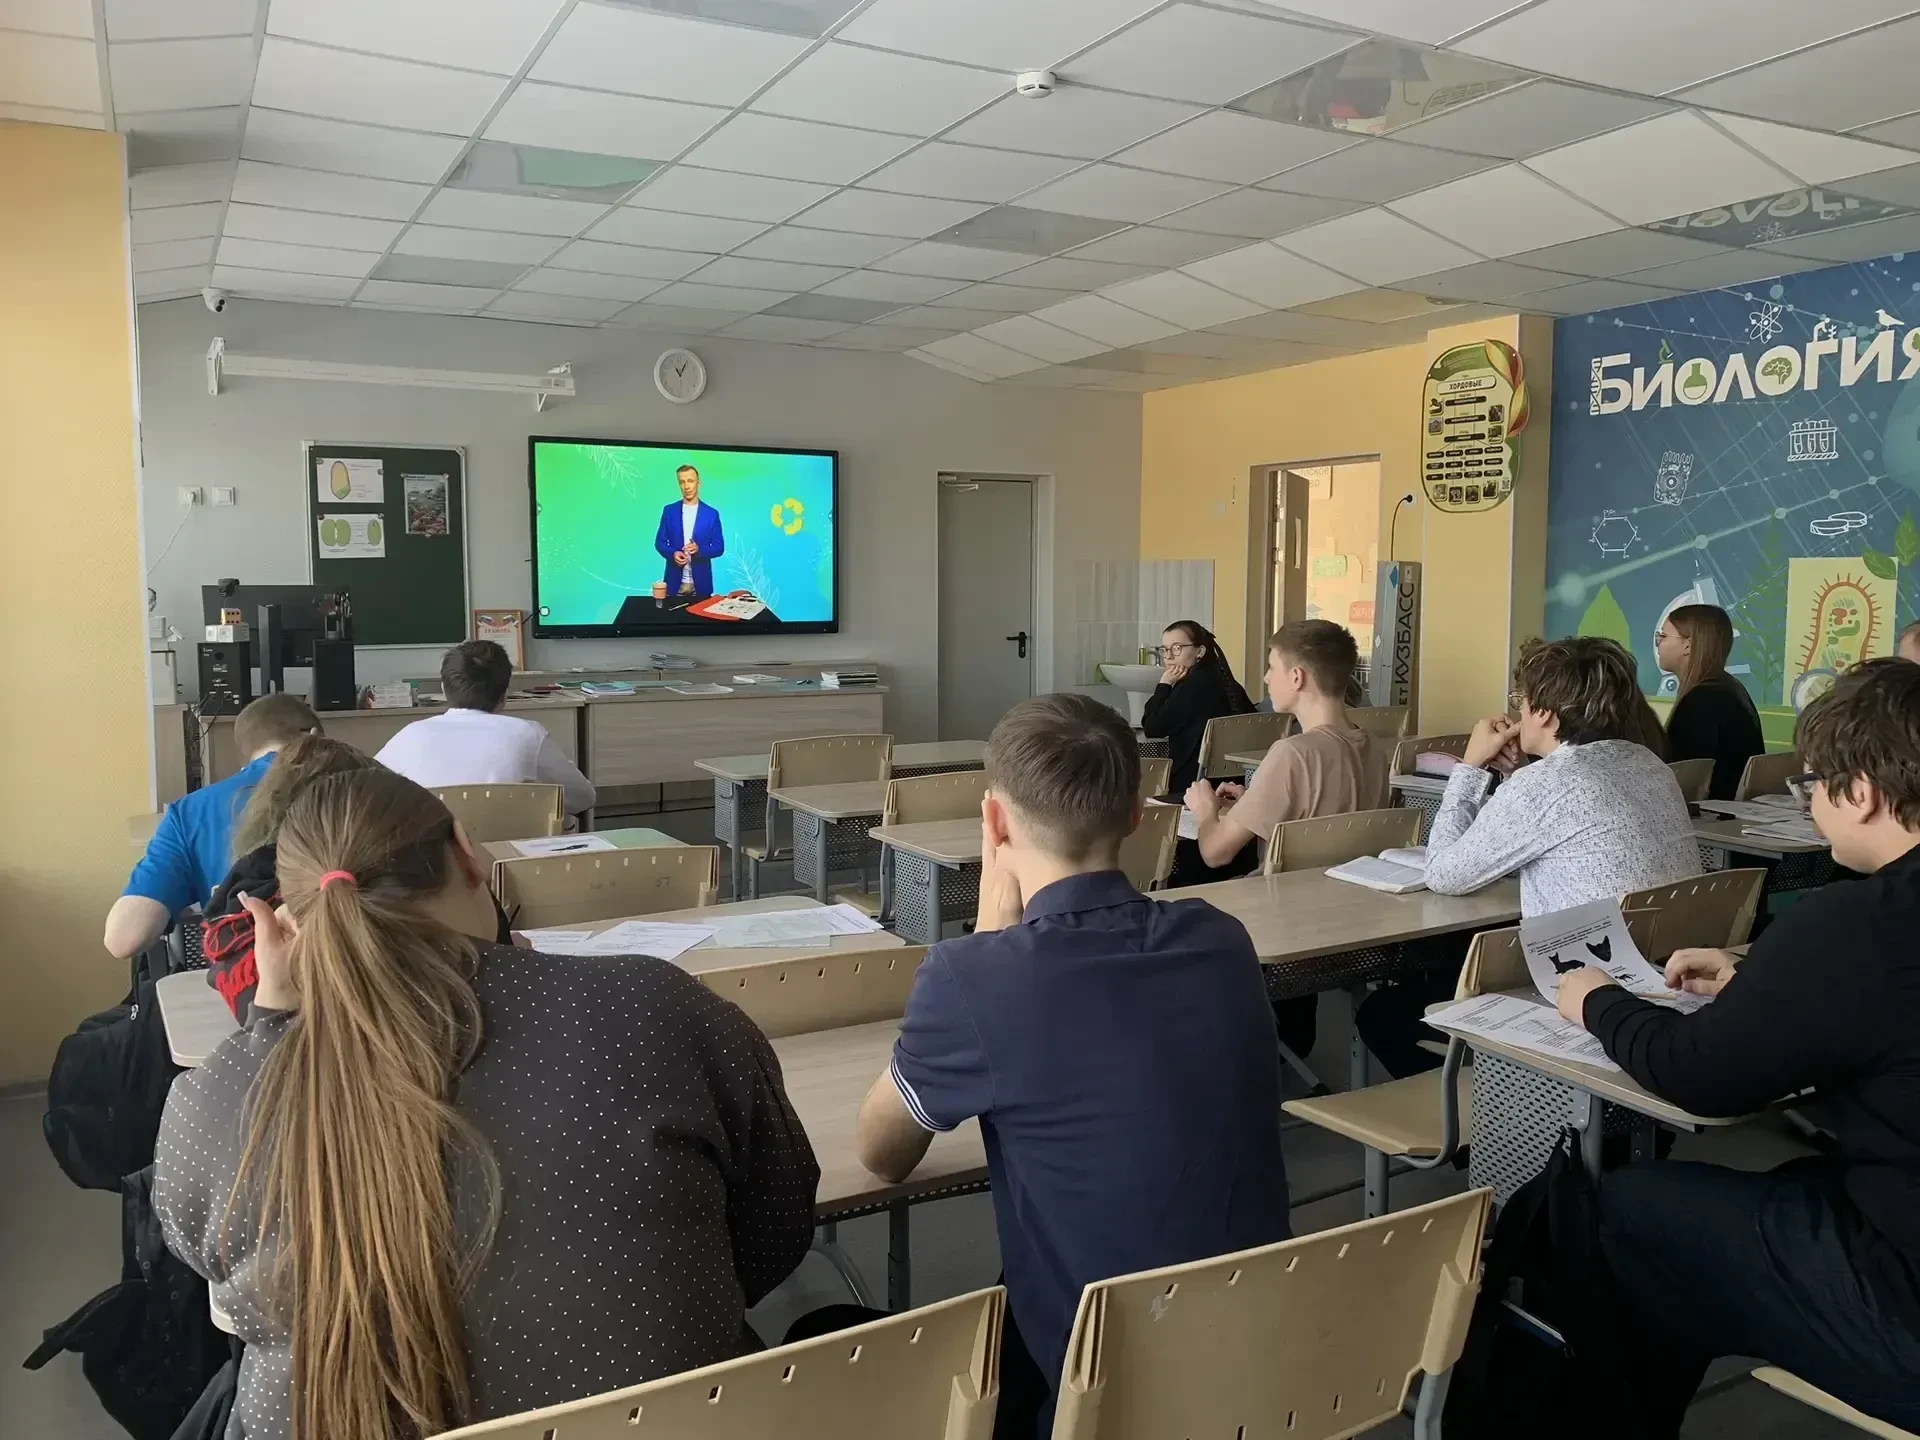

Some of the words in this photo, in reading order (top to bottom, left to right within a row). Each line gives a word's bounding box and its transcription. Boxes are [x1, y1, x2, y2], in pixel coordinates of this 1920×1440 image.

[1448, 379, 1482, 390] ХОРДОВЫЕ
[1395, 583, 1414, 684] КУЗБАСС
[1399, 687, 1408, 705] ЕТ
